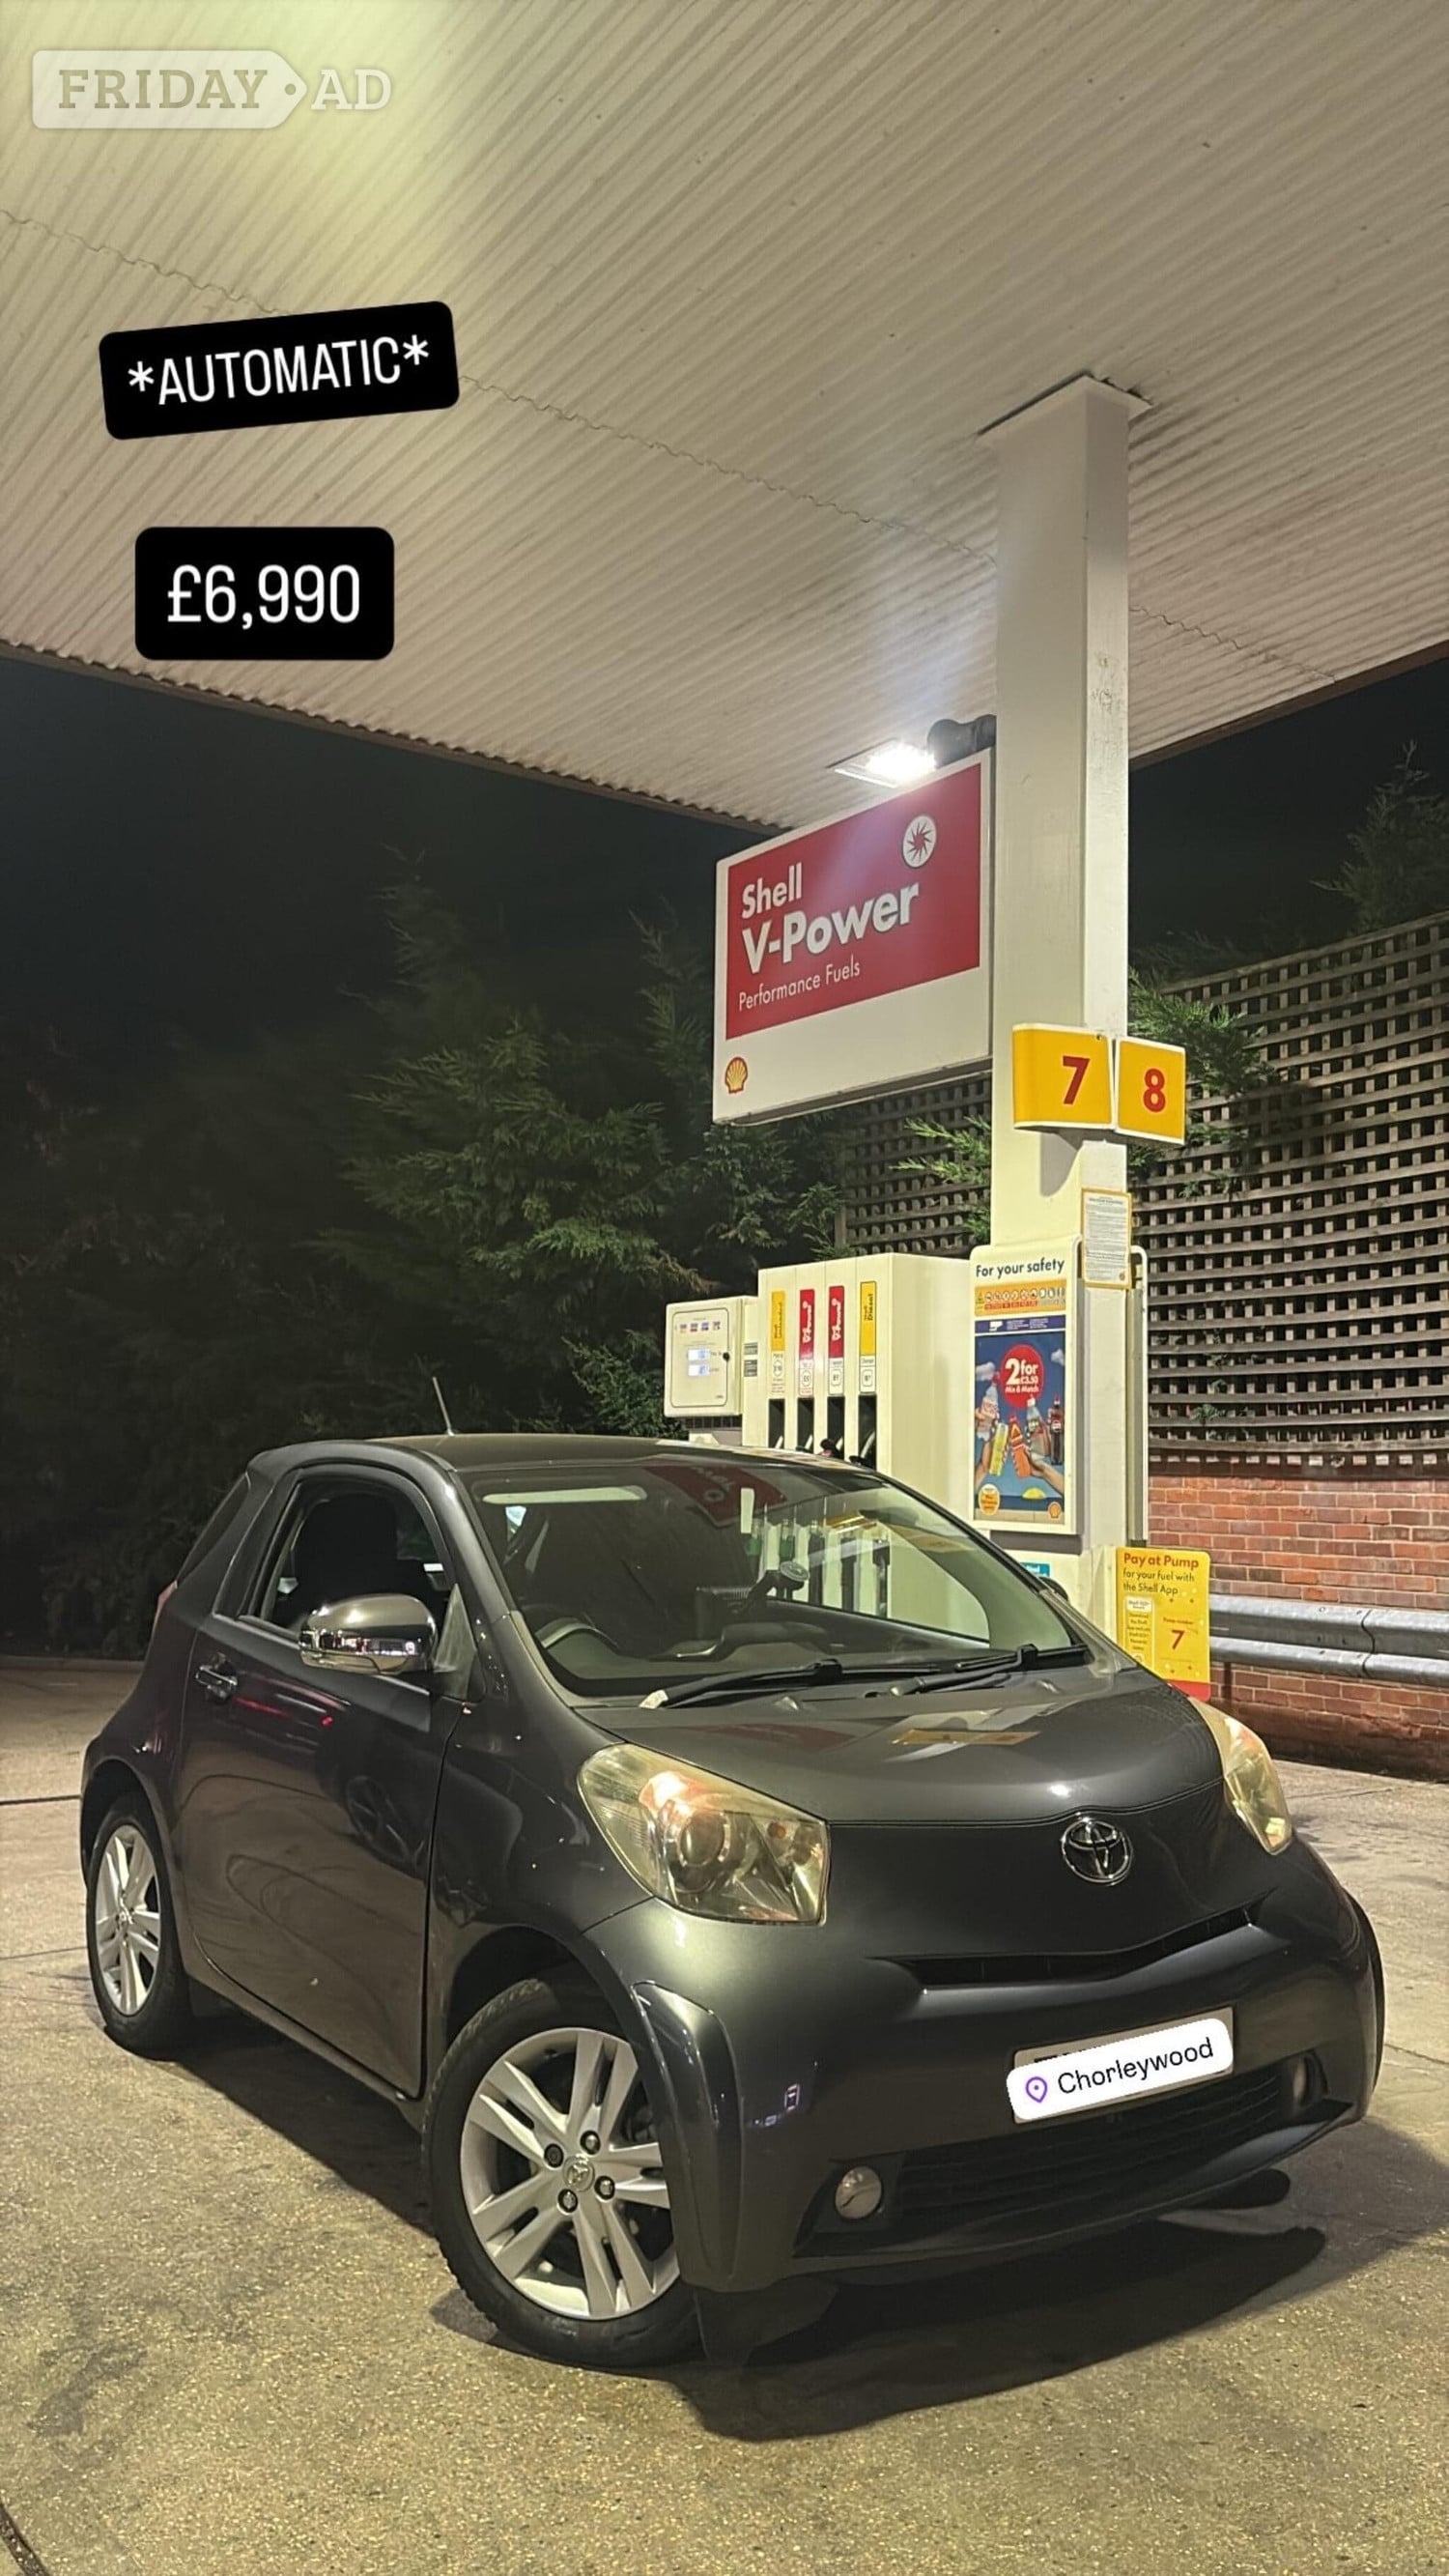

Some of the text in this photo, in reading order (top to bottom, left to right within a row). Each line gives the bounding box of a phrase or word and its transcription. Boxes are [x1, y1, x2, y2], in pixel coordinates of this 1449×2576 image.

[742, 862, 803, 919] Shell
[742, 882, 920, 974] V-Power
[739, 954, 861, 1012] Performance Fuels
[1062, 1055, 1091, 1105] 7
[1143, 1068, 1166, 1113] 8
[976, 1257, 1065, 1279] For your safety
[1005, 1358, 1038, 1385] 2 for
[1123, 1553, 1199, 1571] Pay at Pump
[1123, 1567, 1135, 1578] for
[1157, 1570, 1174, 1581] fuel
[1175, 1572, 1195, 1582] with
[1123, 1582, 1179, 1596] the Shell App
[1171, 1629, 1185, 1650] 7
